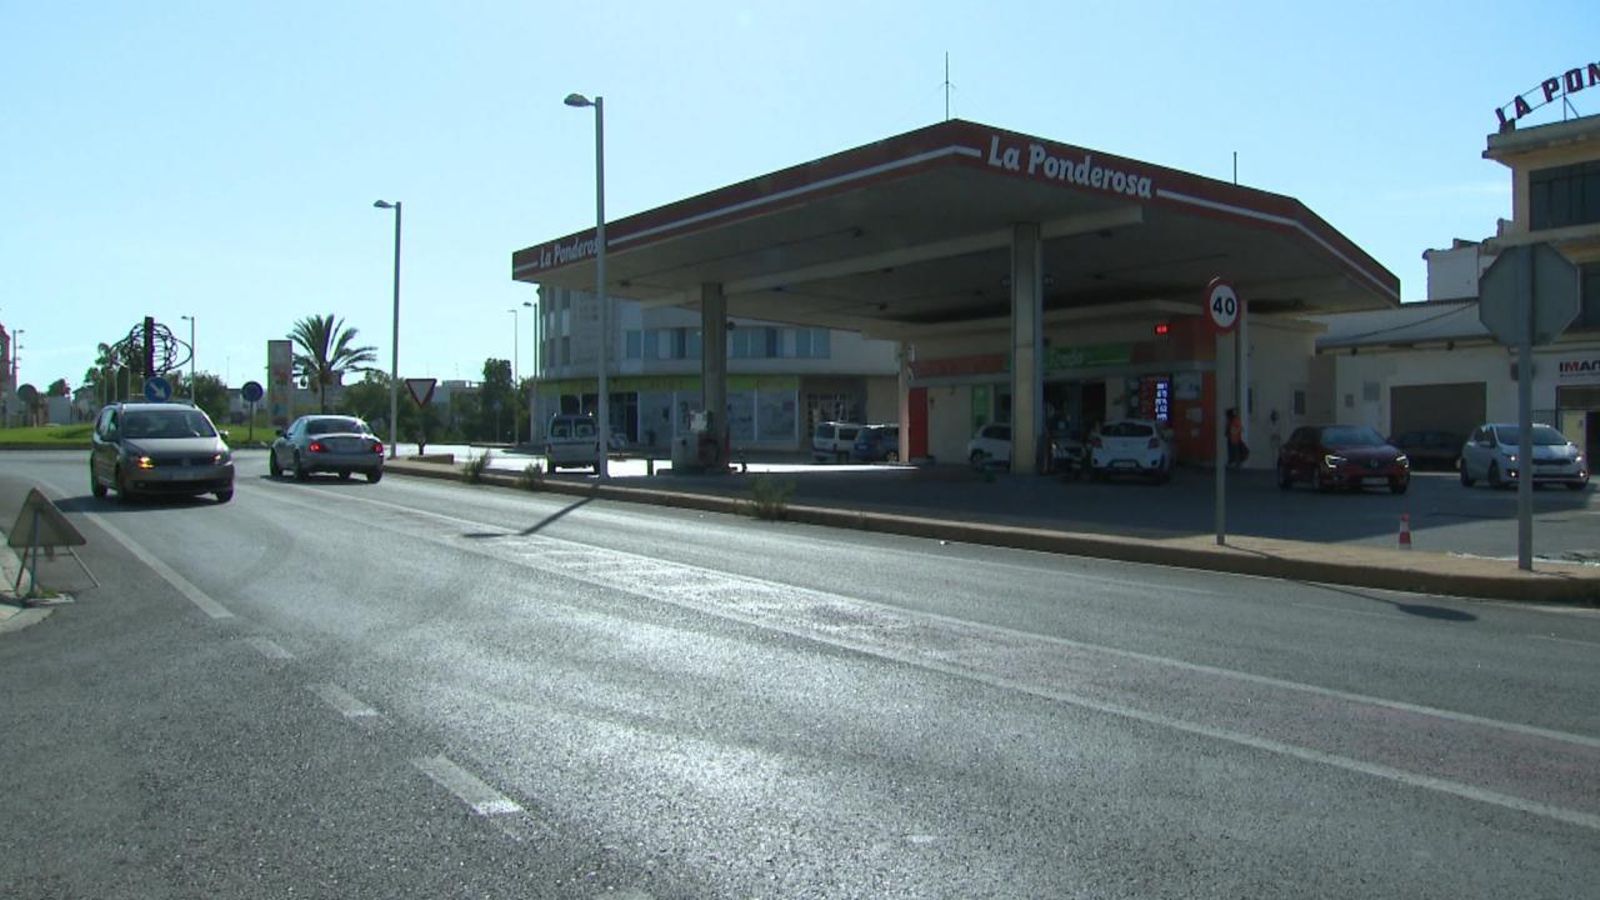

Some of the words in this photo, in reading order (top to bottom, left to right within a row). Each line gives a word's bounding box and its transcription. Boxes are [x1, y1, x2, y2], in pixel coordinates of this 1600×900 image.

[988, 135, 1020, 171] La
[1029, 144, 1152, 198] Ponderosa
[540, 246, 552, 269] La
[1213, 296, 1235, 316] 40
